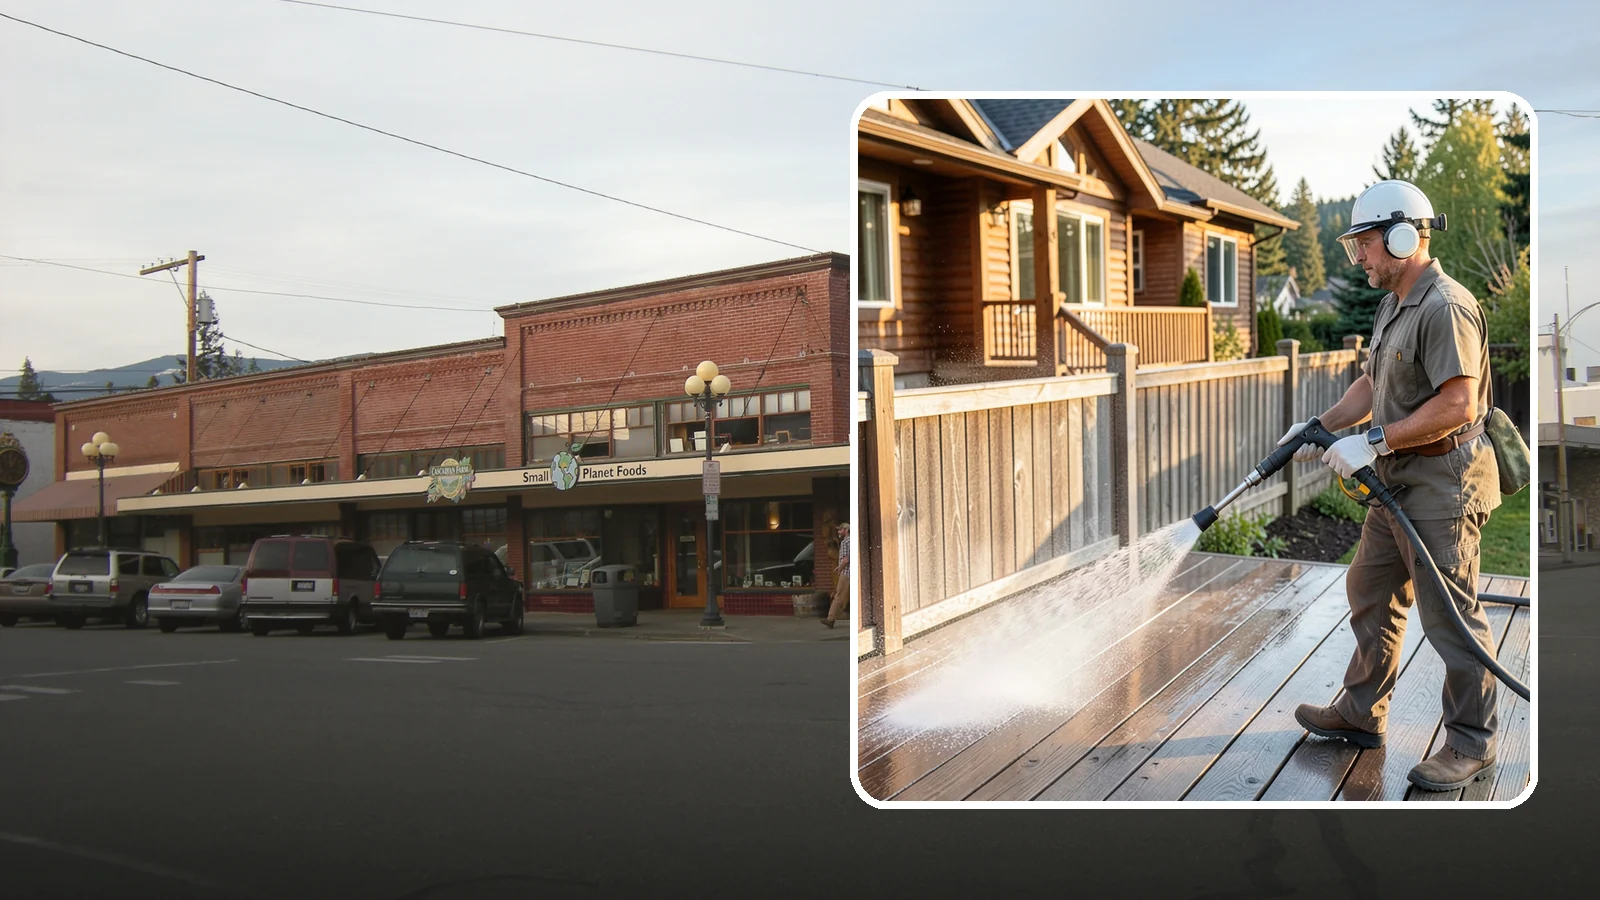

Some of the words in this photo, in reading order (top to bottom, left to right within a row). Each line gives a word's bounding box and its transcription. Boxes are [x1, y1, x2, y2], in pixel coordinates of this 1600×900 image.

[523, 471, 549, 483] Small
[583, 467, 613, 479] Planet
[616, 465, 646, 477] Foods
